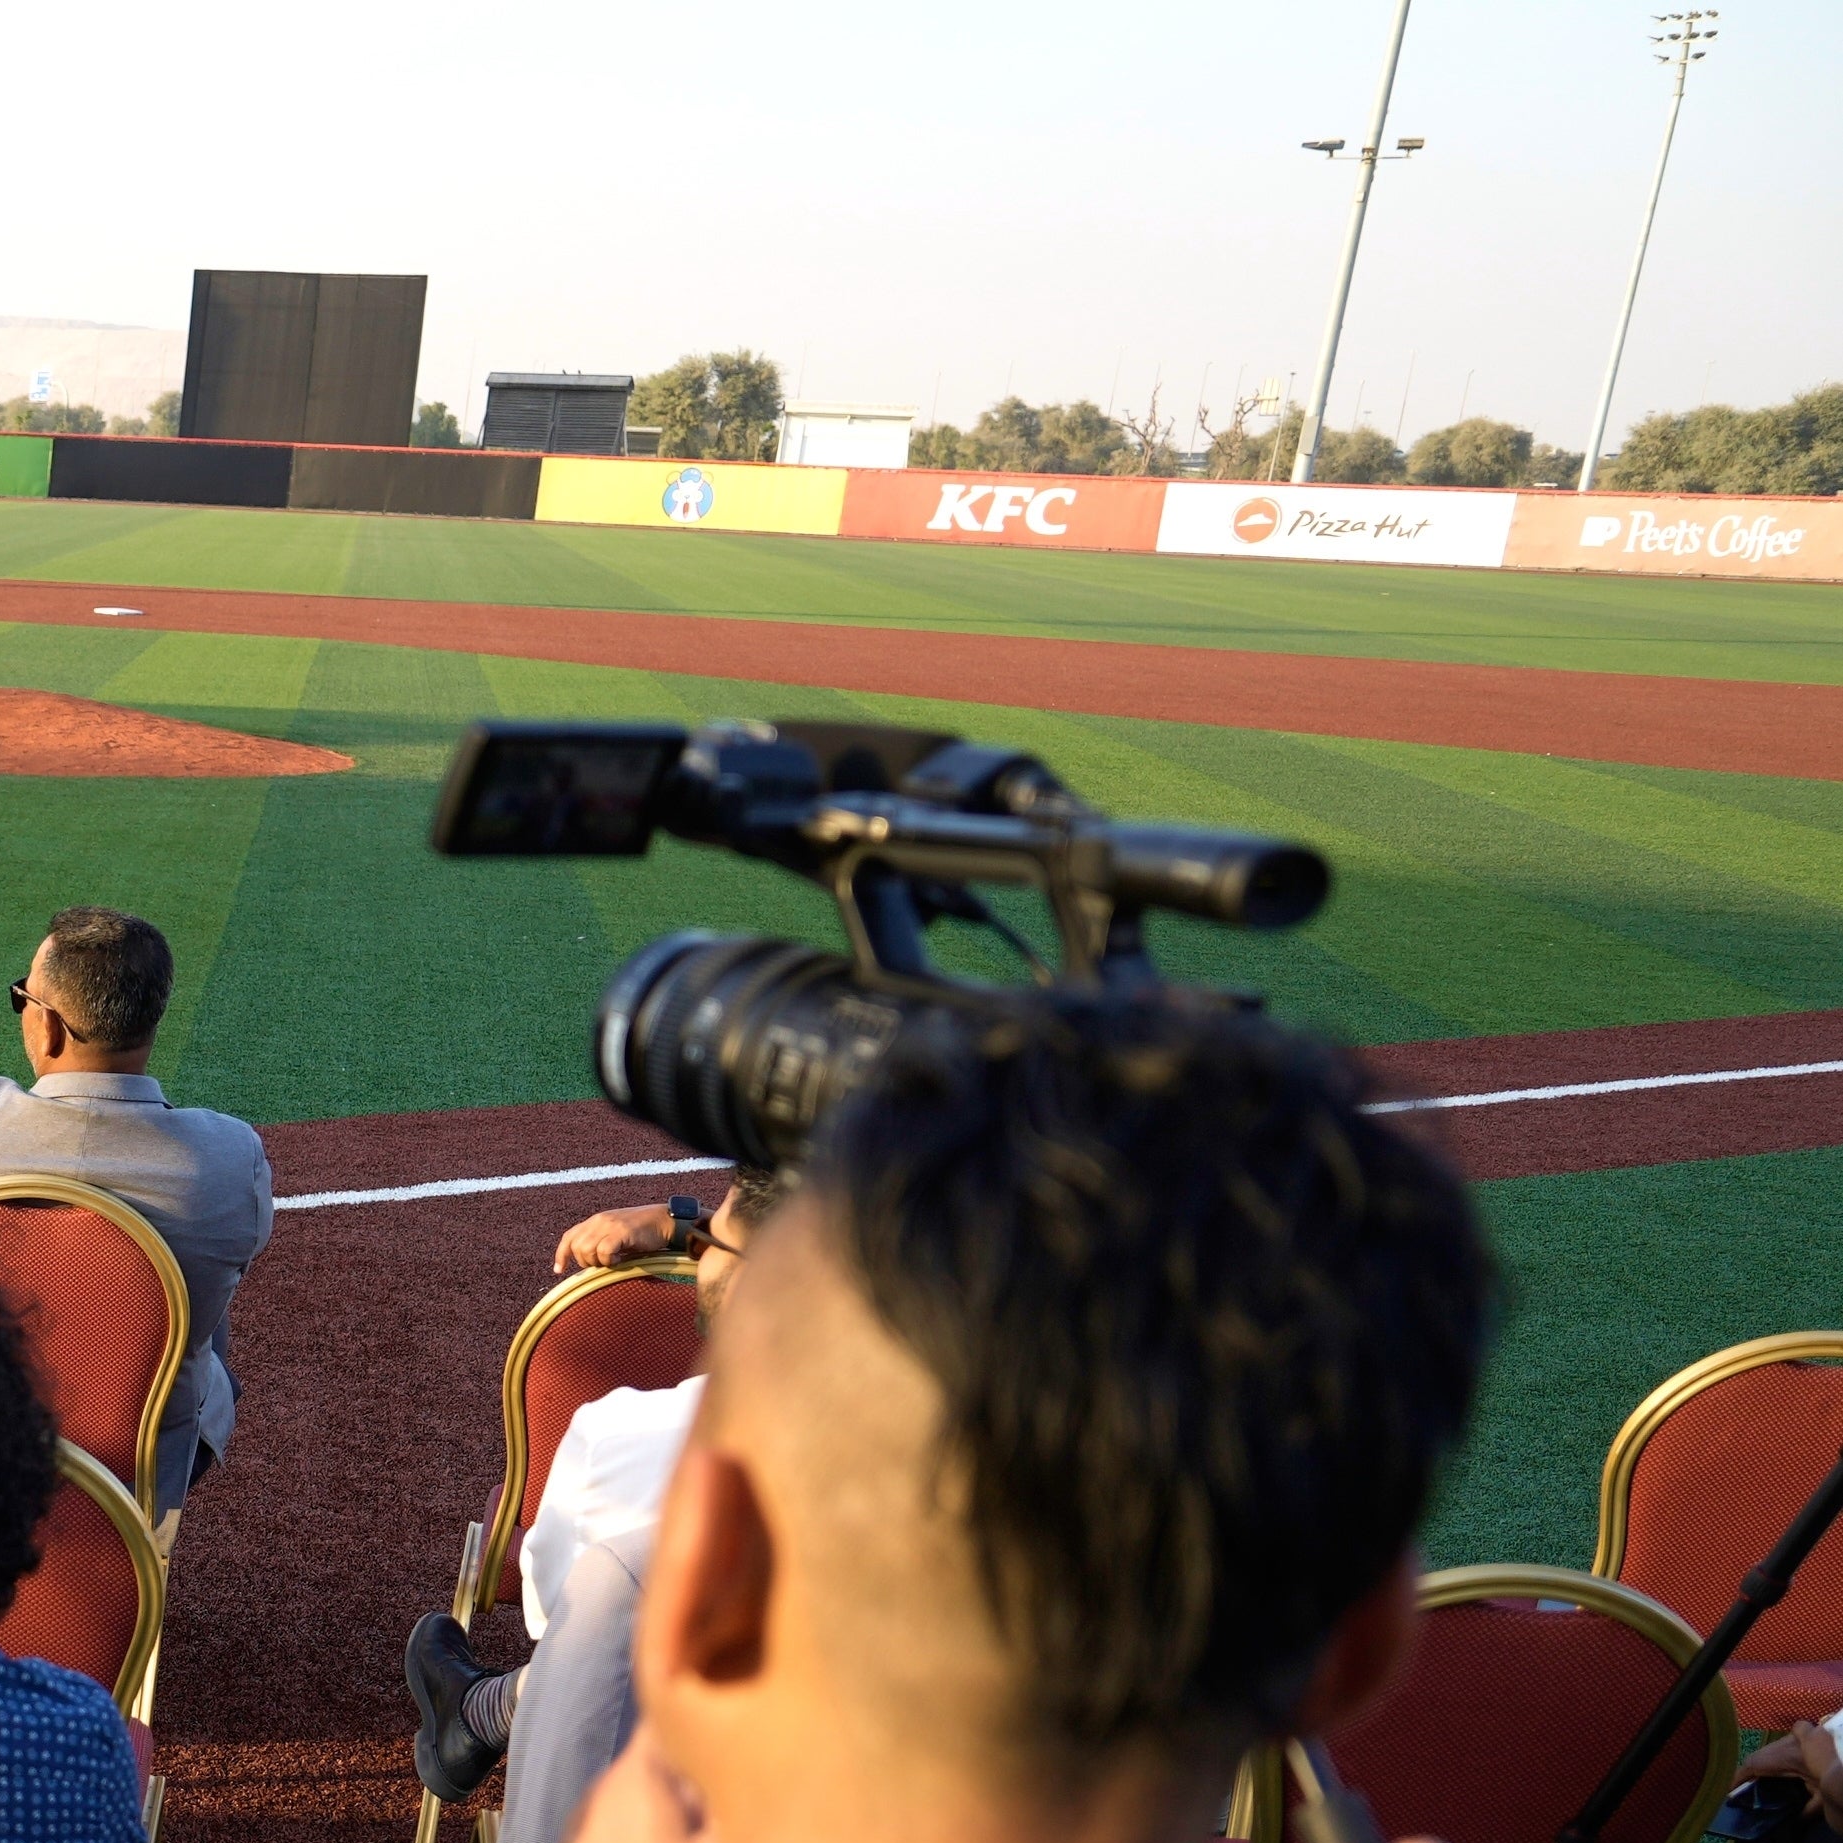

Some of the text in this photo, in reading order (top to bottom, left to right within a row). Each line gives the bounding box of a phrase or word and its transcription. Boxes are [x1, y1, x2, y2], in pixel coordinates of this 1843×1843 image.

[926, 483, 1077, 535] KFC
[1288, 510, 1434, 539] Pizza Hut
[1707, 515, 1803, 563] Coffee
